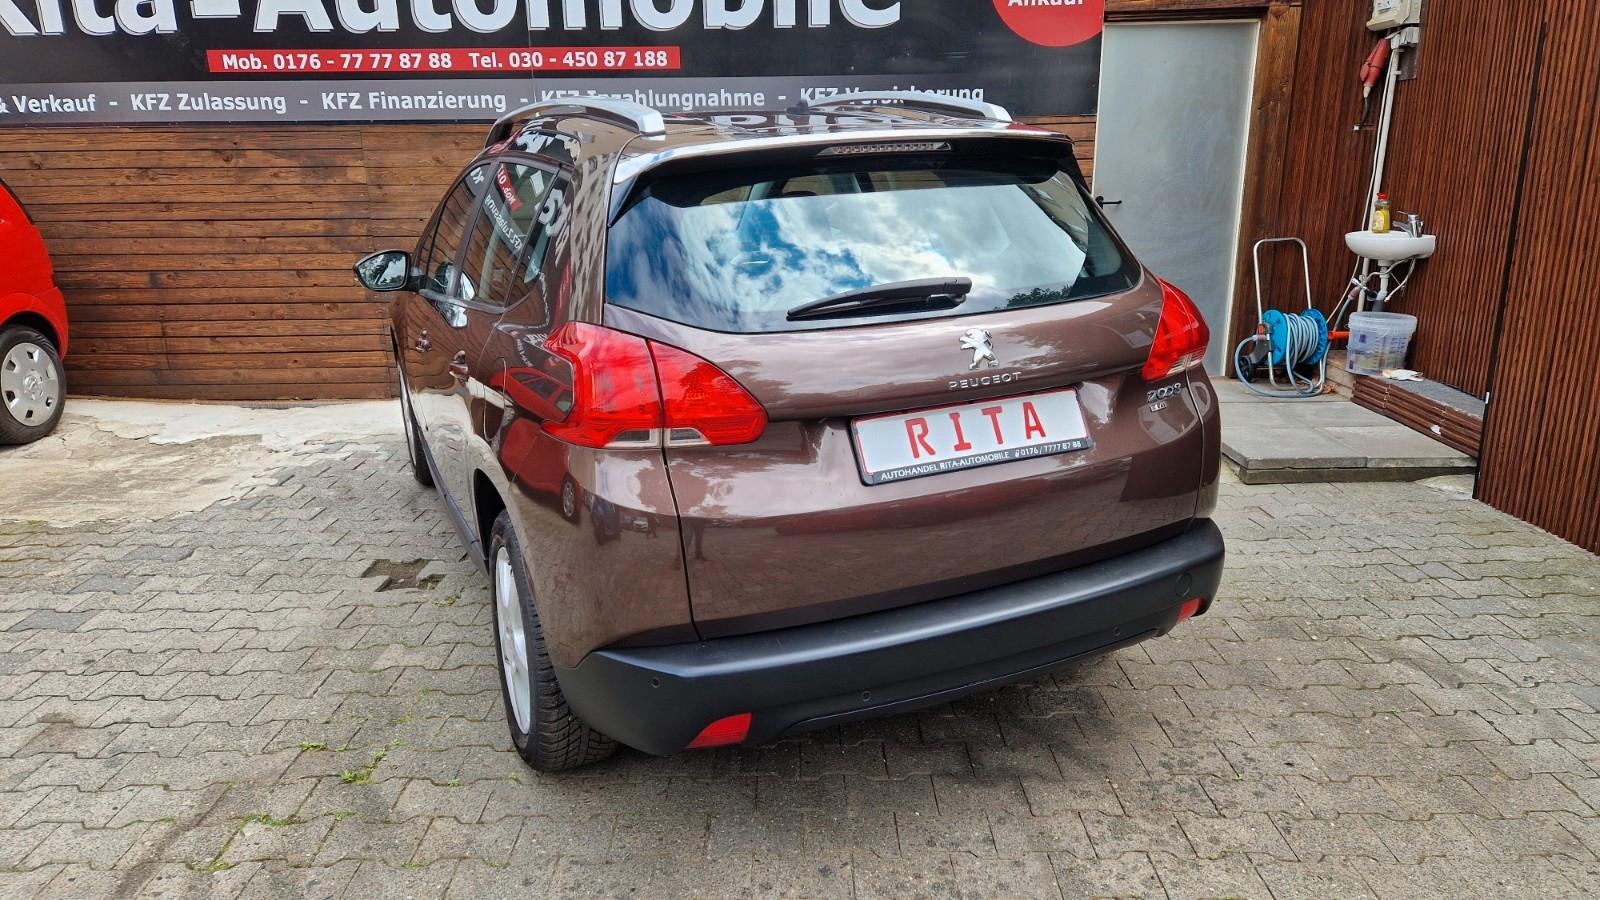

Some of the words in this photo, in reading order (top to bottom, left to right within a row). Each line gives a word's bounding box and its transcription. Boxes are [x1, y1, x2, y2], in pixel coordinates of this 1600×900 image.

[222, 54, 267, 70] Mob.
[273, 53, 321, 69] 0176
[340, 53, 363, 69] 77
[369, 53, 392, 69] 77
[399, 53, 422, 69] 87
[428, 52, 452, 68] 88
[468, 52, 503, 68] Tel.
[508, 52, 543, 67] 030
[562, 51, 598, 67] 450
[604, 51, 627, 67] 87
[634, 51, 668, 66] 188
[12, 94, 96, 113] Verkauf
[130, 94, 172, 111] KFZ
[177, 92, 287, 114] Zulassung
[321, 93, 362, 110] KFZ
[369, 91, 507, 112] Finanzierung
[948, 371, 1022, 390] PEUGEOT
[1147, 383, 1182, 402] 2008
[905, 401, 1046, 459] RITA
[881, 463, 939, 480] AUTOHANDEL
[940, 451, 1010, 471] RITA-AUTOMOBILE
